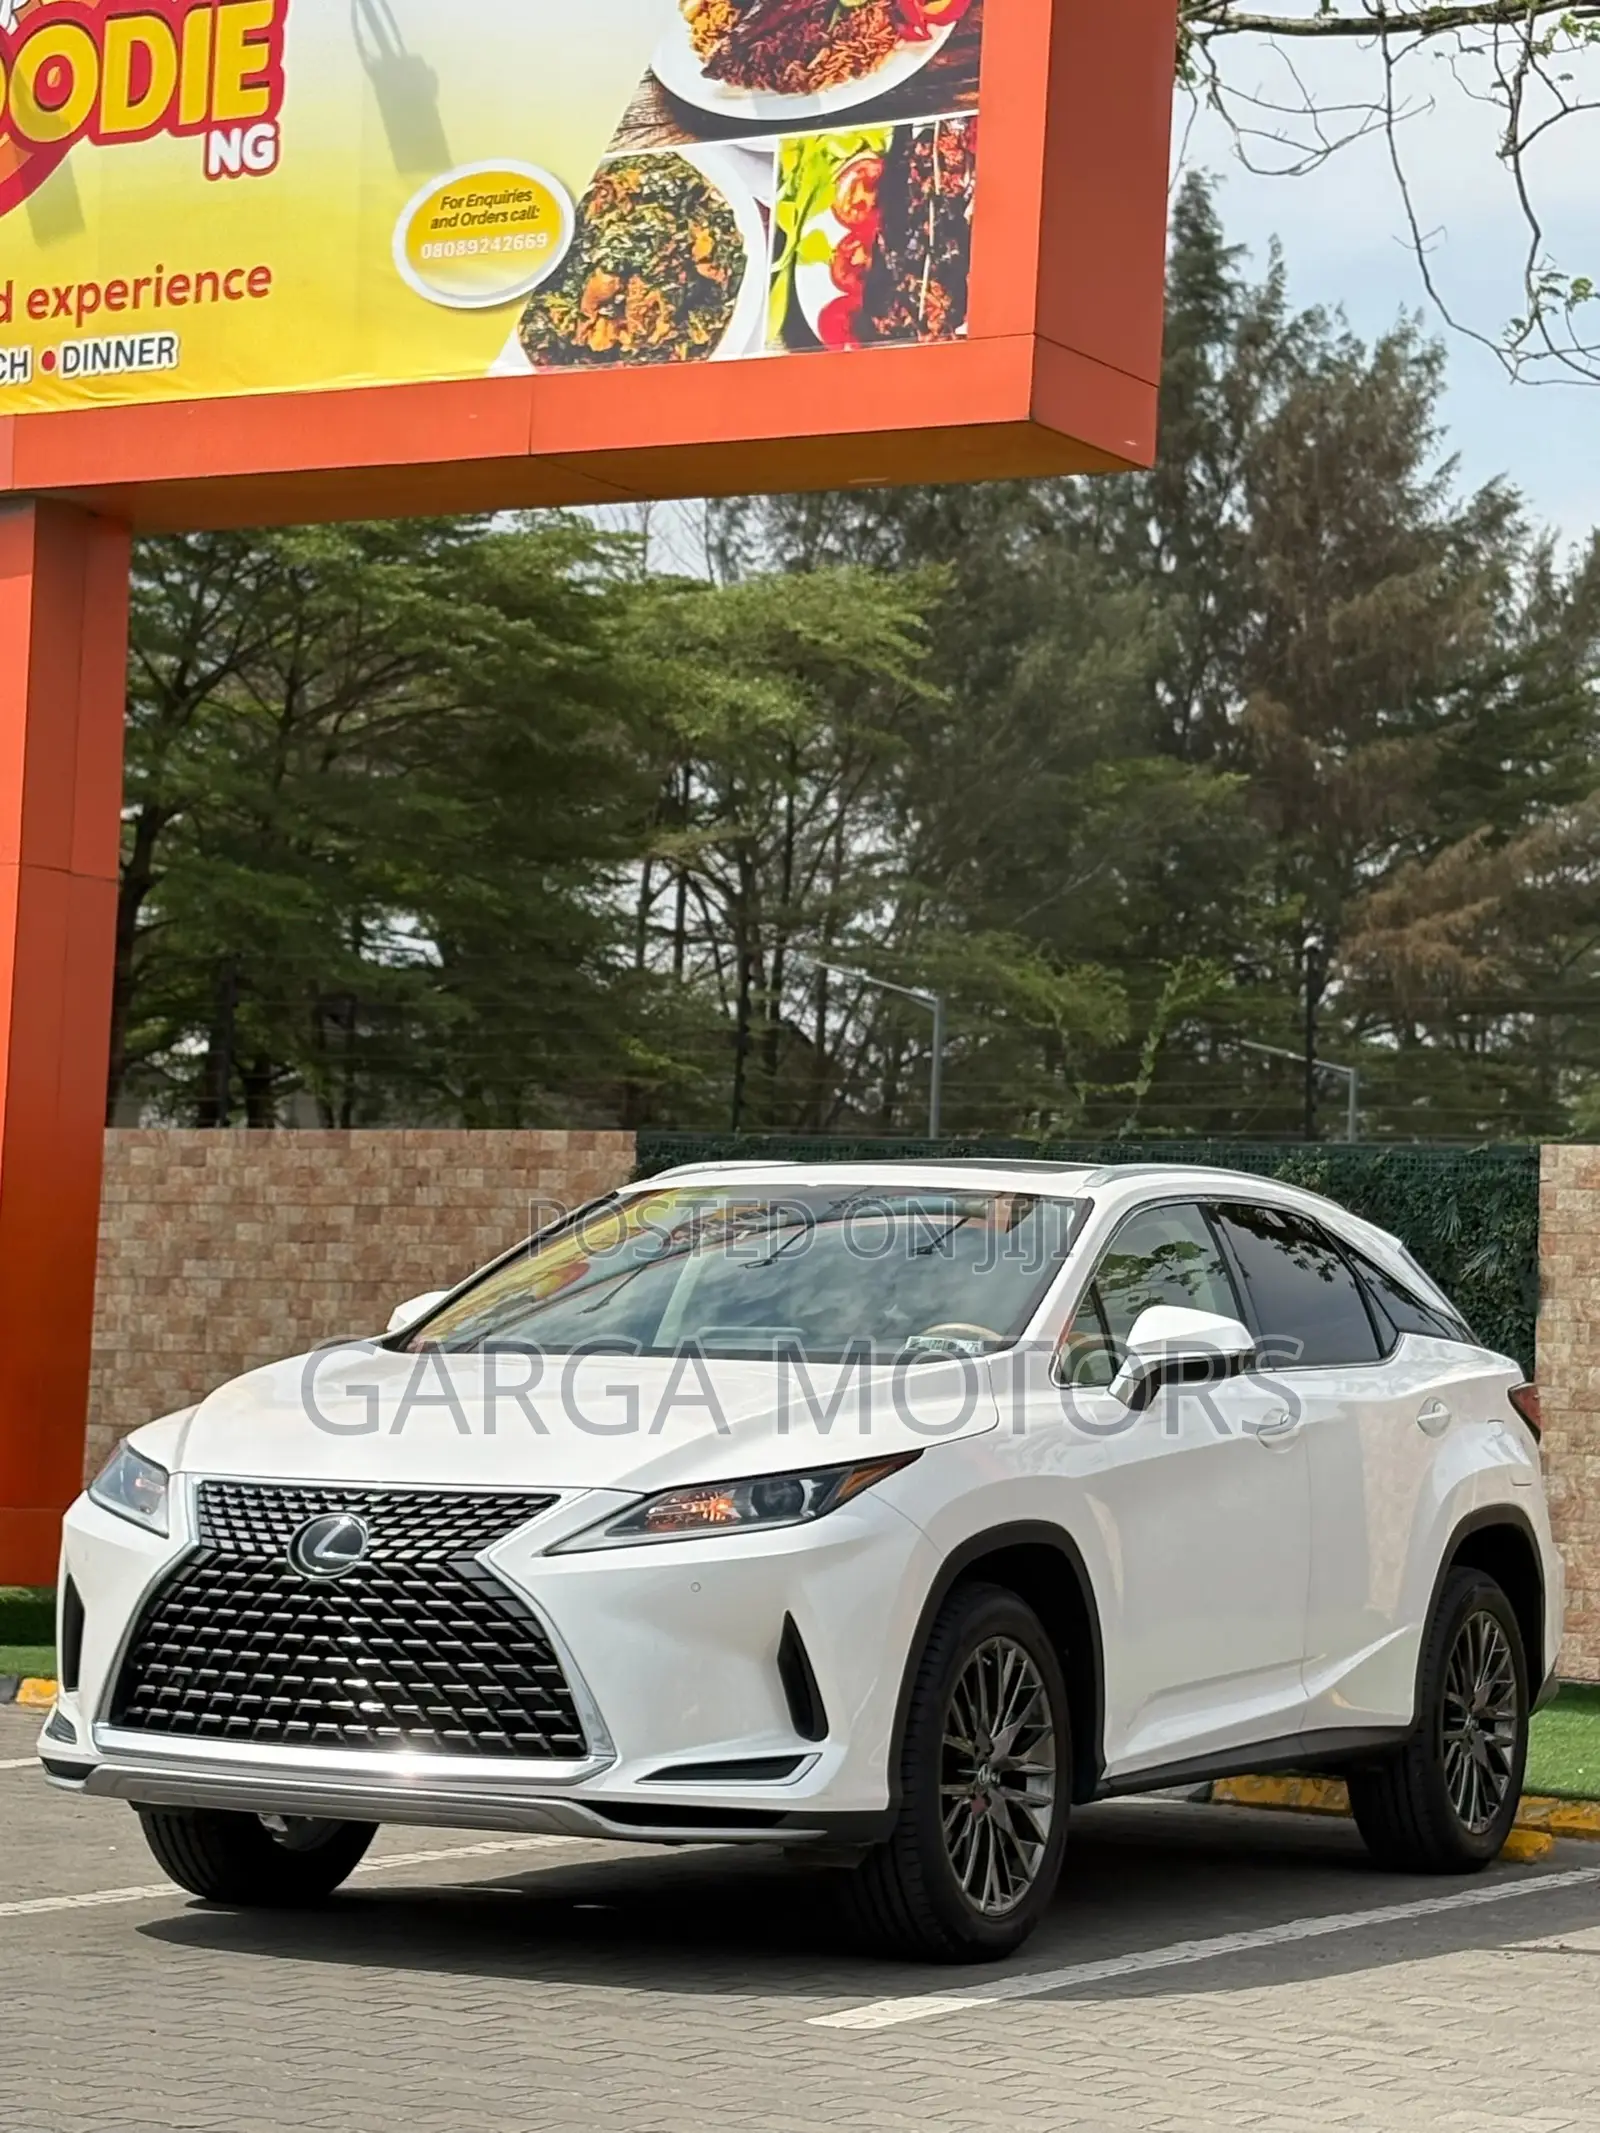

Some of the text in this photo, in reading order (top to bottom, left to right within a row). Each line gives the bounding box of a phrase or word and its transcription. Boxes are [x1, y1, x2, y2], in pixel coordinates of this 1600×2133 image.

[0, 1, 275, 143] ODIE
[207, 123, 276, 176] NG
[440, 189, 532, 210] For Enquiries
[430, 213, 458, 229] and
[460, 211, 508, 226] Orders
[421, 233, 547, 259] 08089242669
[26, 264, 272, 328] experience
[63, 336, 175, 373] DINNER
